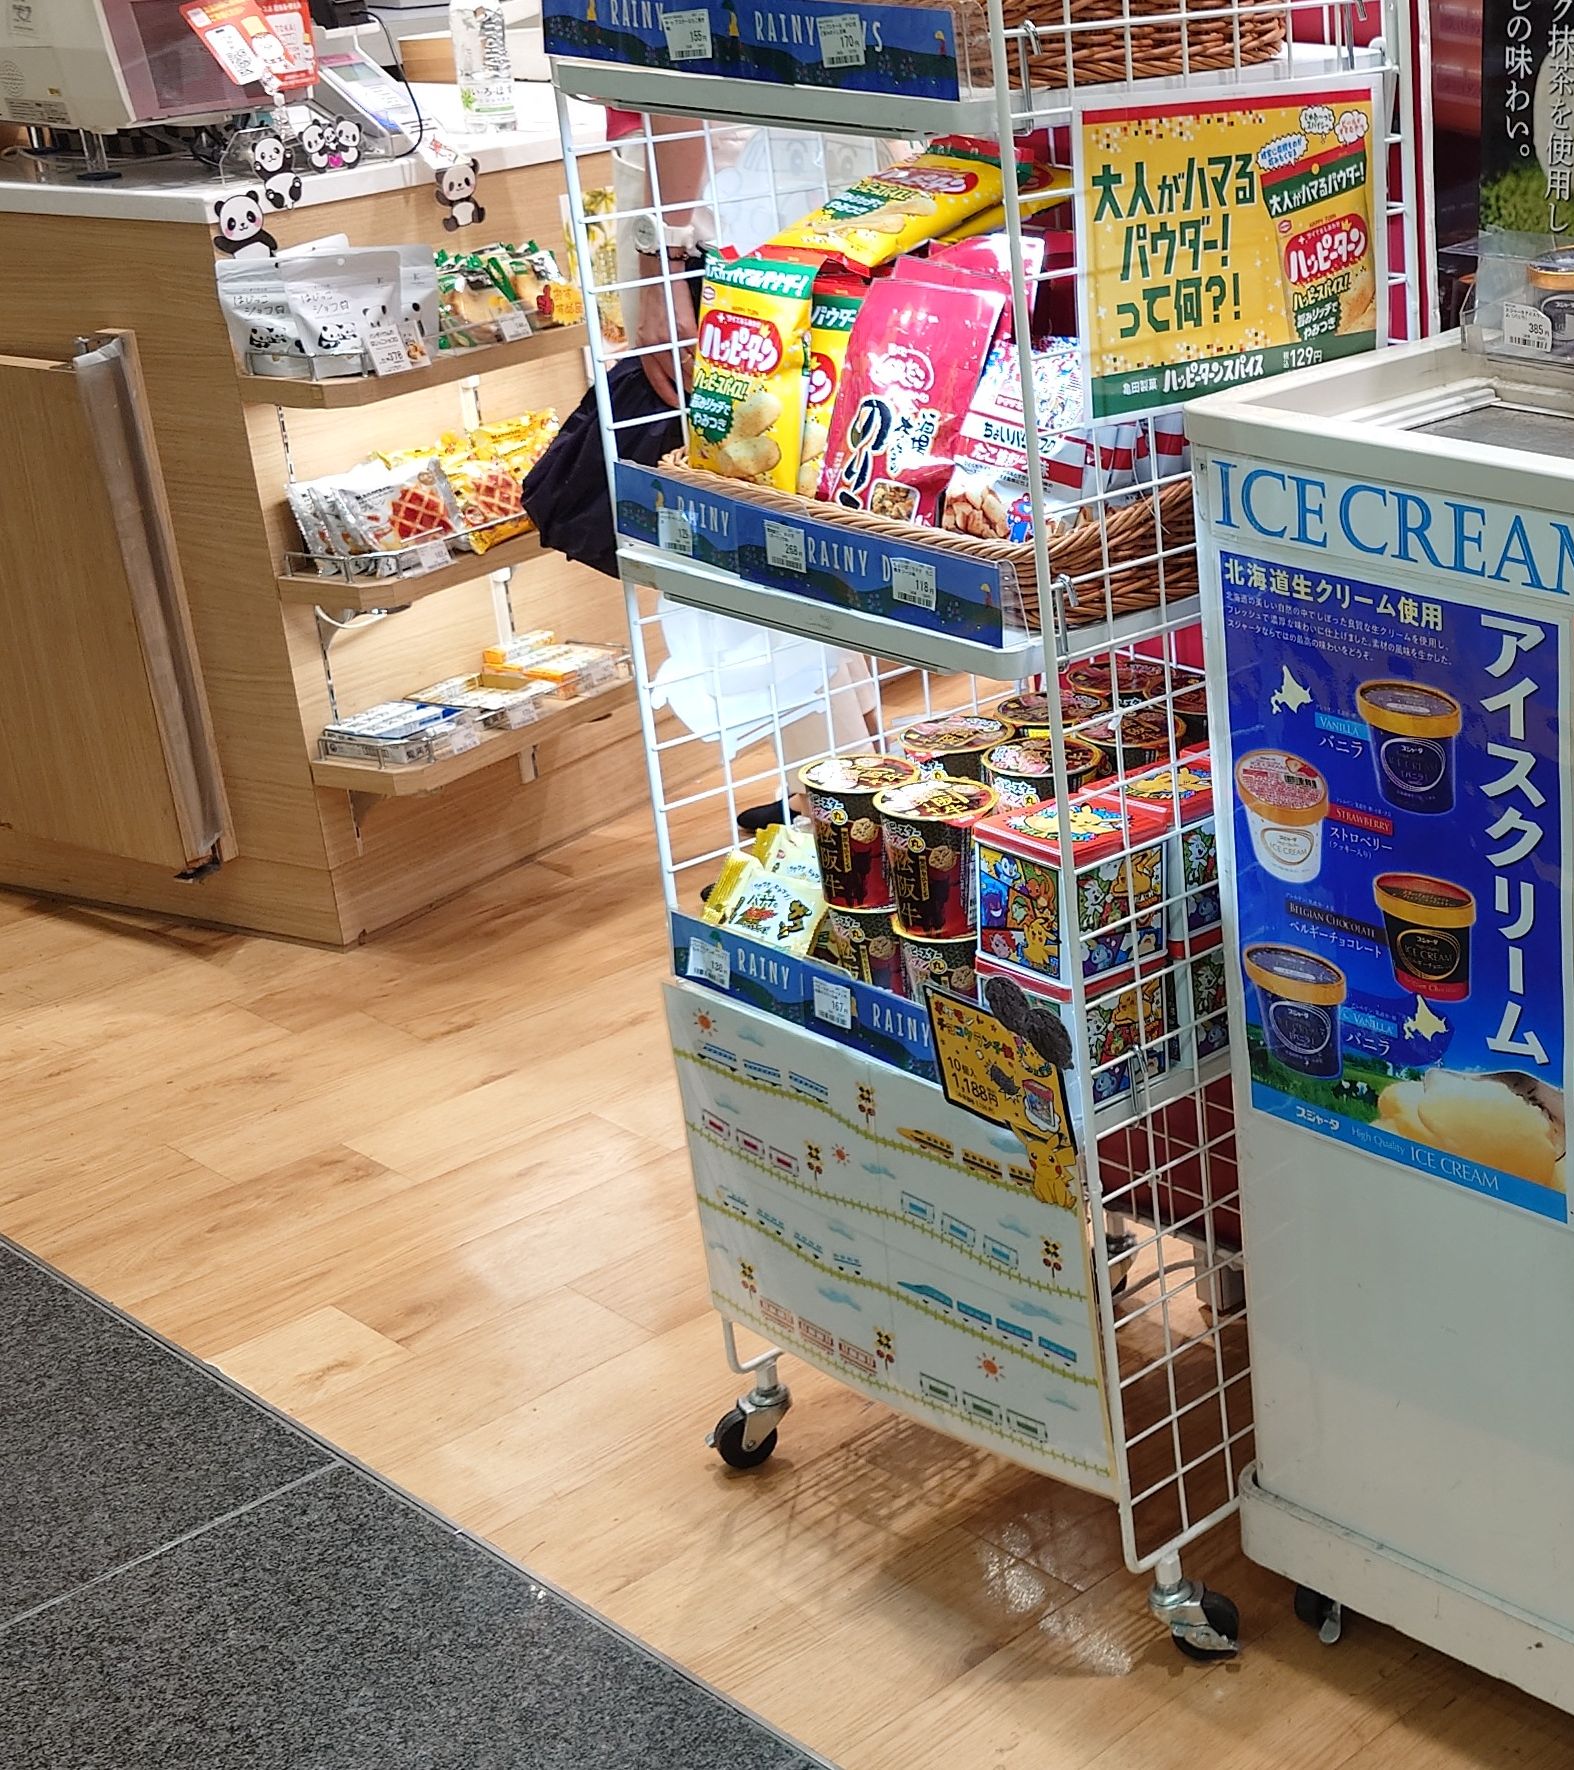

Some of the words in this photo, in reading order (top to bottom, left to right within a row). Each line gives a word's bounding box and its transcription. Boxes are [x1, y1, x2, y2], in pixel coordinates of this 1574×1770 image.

[610, 0, 664, 31] RAINY
[755, 11, 814, 47] RAINY
[1091, 153, 1257, 223] 大人がハマる
[1268, 162, 1366, 216] 大人がハマるパウダー!
[1119, 212, 1231, 283] パウダー!
[1289, 228, 1367, 284] ハッピーターン
[1116, 272, 1241, 339] って何?!
[1162, 354, 1266, 393] ハッピーターンスパイス
[1289, 346, 1324, 367] 129円
[1212, 460, 1329, 549] ICE
[807, 536, 868, 577] RAINY
[1224, 557, 1445, 632] 北海道生クリーム使用
[1319, 715, 1360, 736] VANILLA
[1319, 735, 1364, 760] バニラ
[1329, 826, 1393, 851] ストロベリー
[1335, 807, 1391, 833] STRAWBERRY
[1479, 613, 1552, 1067] アイスクリーム
[817, 820, 845, 899] 松阪牛
[896, 848, 923, 928] 松阪牛
[1289, 901, 1325, 923] BELGIAN
[1325, 912, 1376, 939] CHOCOLATE
[1289, 921, 1382, 960] ベルギーチョコレート
[737, 948, 791, 990] RAINY
[872, 1003, 931, 1049] RAINY
[1346, 1032, 1391, 1056] バニラ
[1296, 1105, 1340, 1132] スジャータ
[1351, 1124, 1372, 1144] High
[1411, 1146, 1436, 1170] ICE
[1440, 1157, 1500, 1192] CREAM
